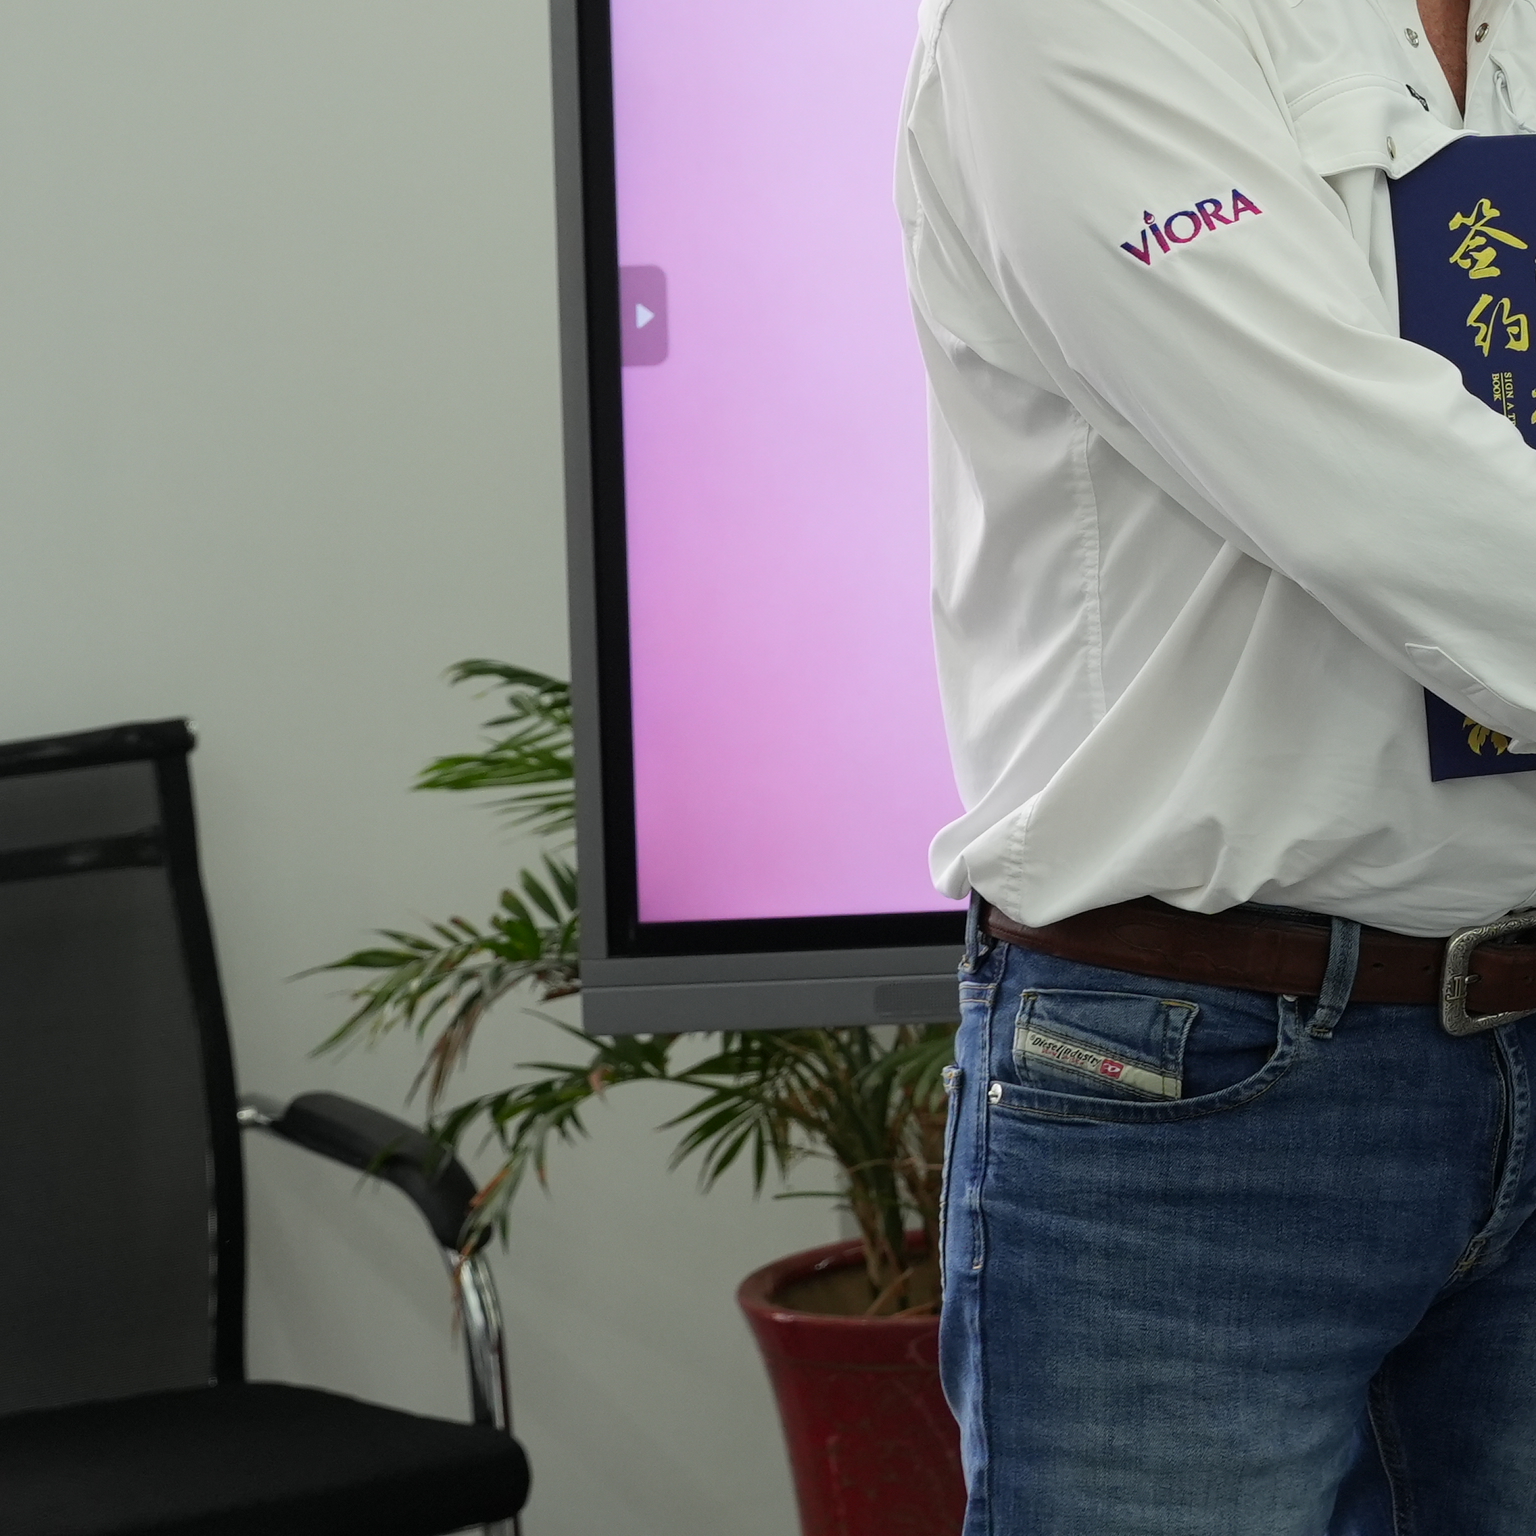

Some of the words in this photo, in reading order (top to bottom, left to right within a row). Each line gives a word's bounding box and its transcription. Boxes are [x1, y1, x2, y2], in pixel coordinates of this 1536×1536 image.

[1492, 373, 1501, 401] BOOK
[1504, 372, 1514, 398] SIGN
[1507, 402, 1515, 410] A
